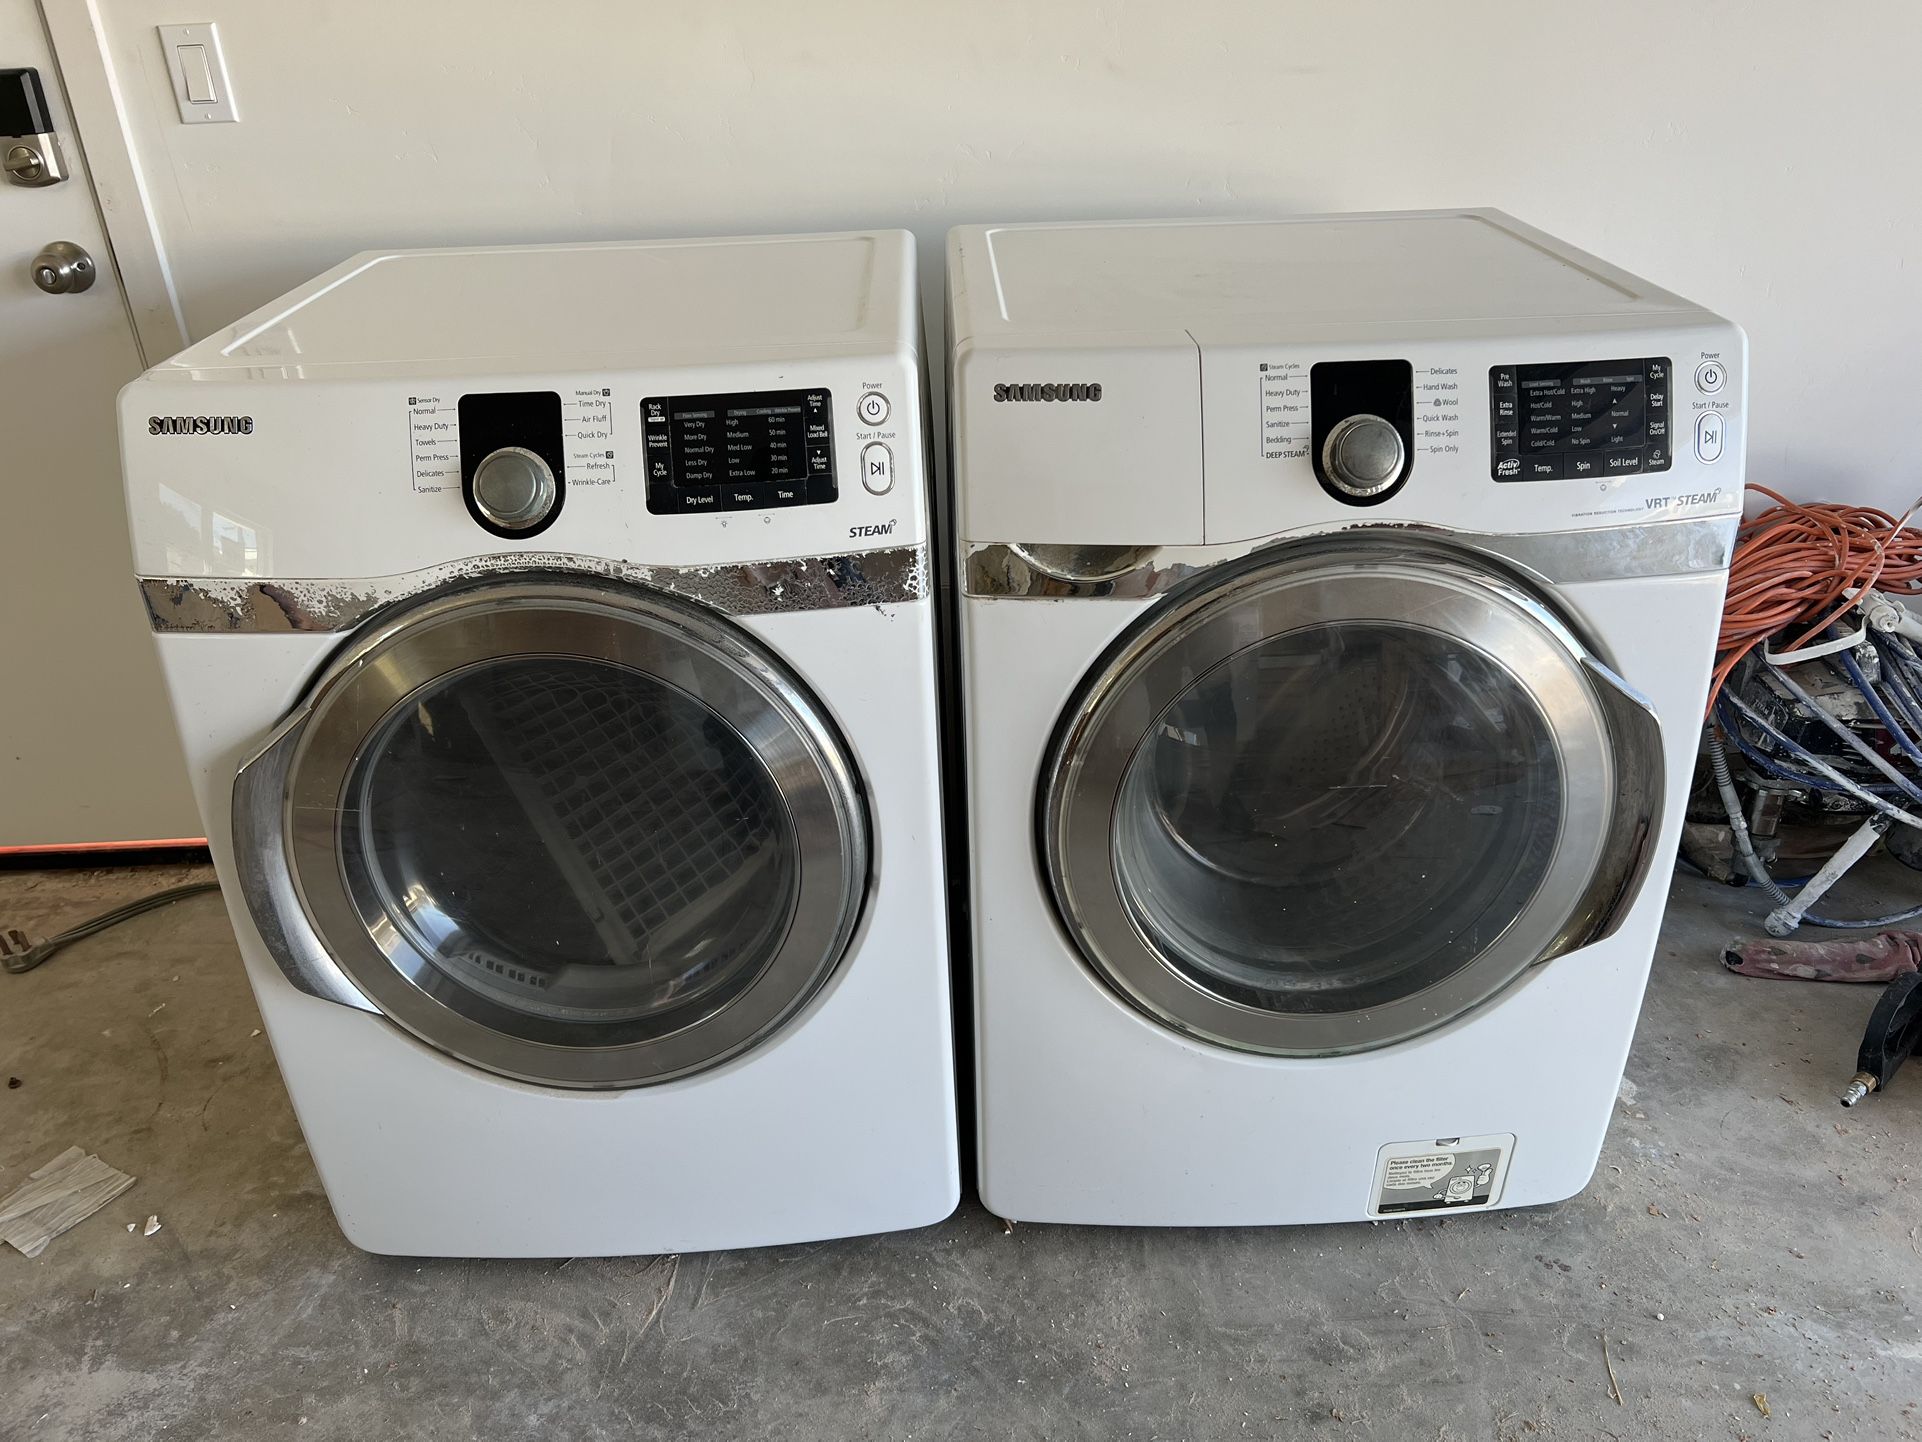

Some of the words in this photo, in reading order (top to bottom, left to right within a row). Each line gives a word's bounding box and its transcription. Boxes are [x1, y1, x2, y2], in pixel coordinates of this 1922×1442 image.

[993, 383, 1102, 402] SAMSUNG
[1266, 390, 1284, 398] Heavy
[1286, 389, 1300, 397] Duty
[595, 400, 606, 408] Dry
[148, 416, 253, 435] SAMSUNG
[434, 422, 449, 430] Duty
[1266, 420, 1289, 428] Sanitize
[597, 431, 608, 439] Dry
[856, 432, 872, 440] Start
[1425, 430, 1459, 438] Rinse+Spin
[1266, 436, 1291, 444] Bedding
[705, 446, 714, 454] Dry
[1430, 446, 1443, 454] Spin
[1445, 446, 1459, 454] Only
[655, 462, 664, 470] My
[698, 459, 707, 467] Dry
[1498, 460, 1518, 470] Activ
[1577, 462, 1590, 470] Spin
[1610, 458, 1621, 466] Soil
[1622, 458, 1638, 466] Level
[653, 469, 667, 477] Cycle
[1534, 465, 1553, 473] Temp.
[686, 472, 701, 480] Damp
[572, 478, 611, 486] Wrinkle-Care
[734, 493, 753, 502] Temp.
[1677, 493, 1717, 506] STEAM
[849, 524, 892, 537] STEAM
